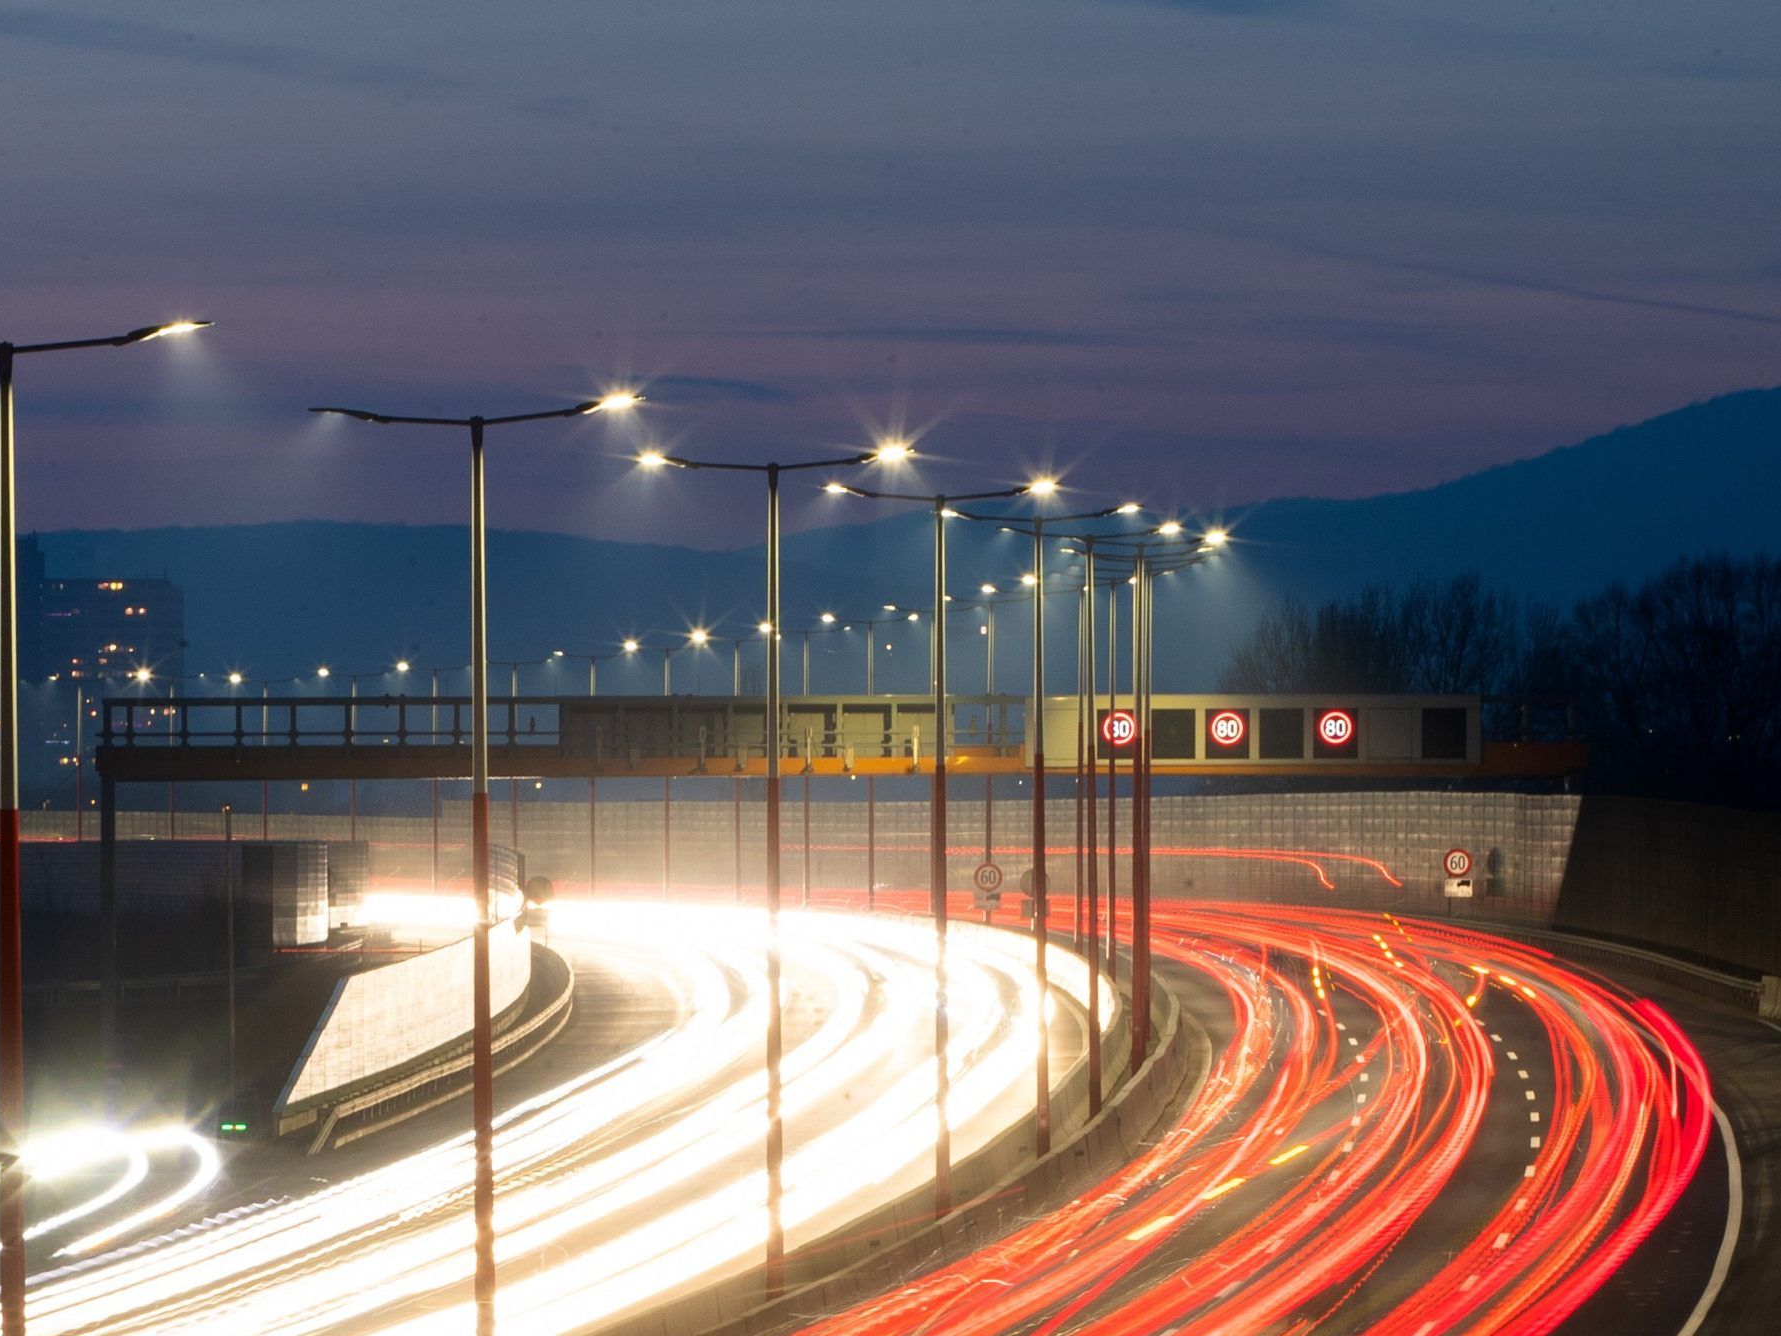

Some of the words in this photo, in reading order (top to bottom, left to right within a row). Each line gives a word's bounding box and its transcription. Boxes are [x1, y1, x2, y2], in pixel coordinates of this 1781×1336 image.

[1216, 719, 1238, 738] 80
[1325, 719, 1346, 737] 80
[1450, 855, 1466, 871] 60
[980, 870, 997, 885] 60
